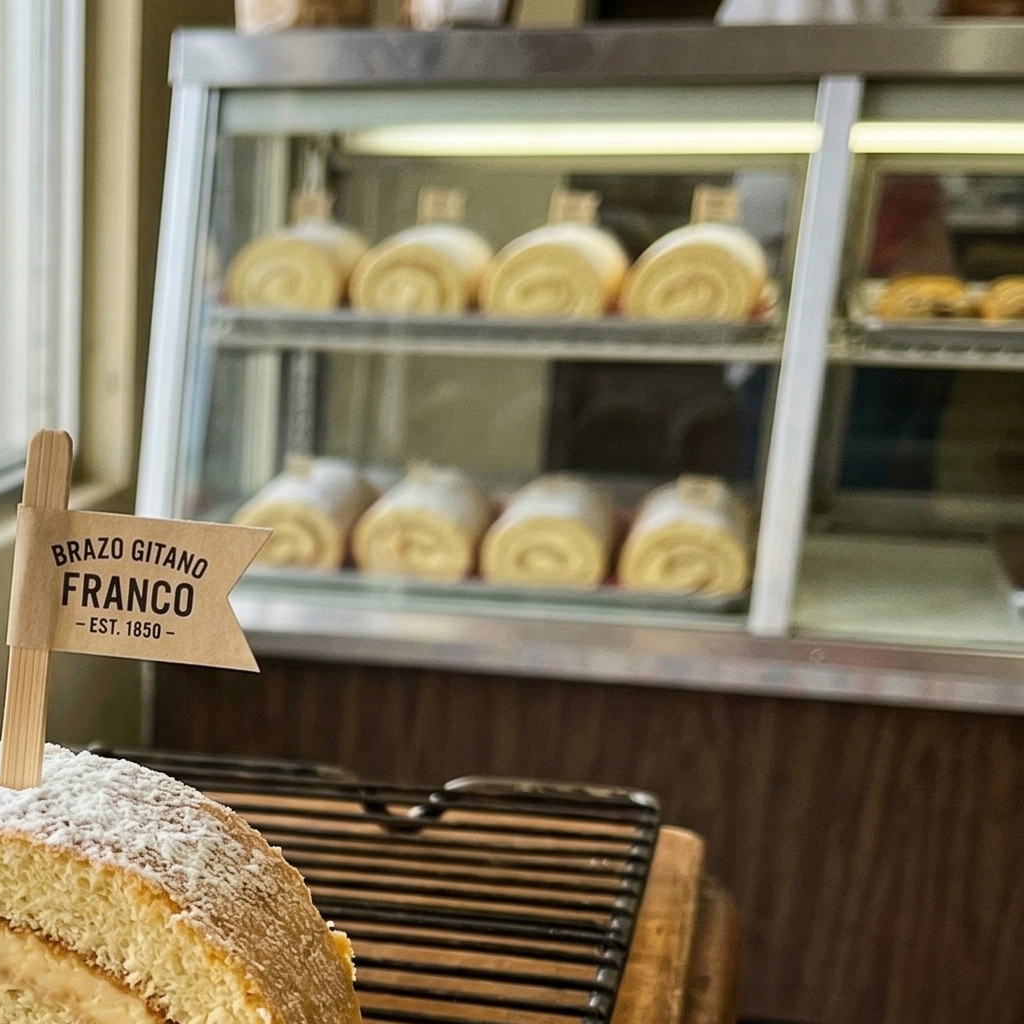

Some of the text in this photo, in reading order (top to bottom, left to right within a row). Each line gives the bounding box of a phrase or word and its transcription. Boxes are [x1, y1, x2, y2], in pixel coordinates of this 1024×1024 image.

[51, 537, 209, 579] BRAZO GITANO
[61, 572, 195, 617] FRANCO
[89, 617, 162, 639] EST. 1850
